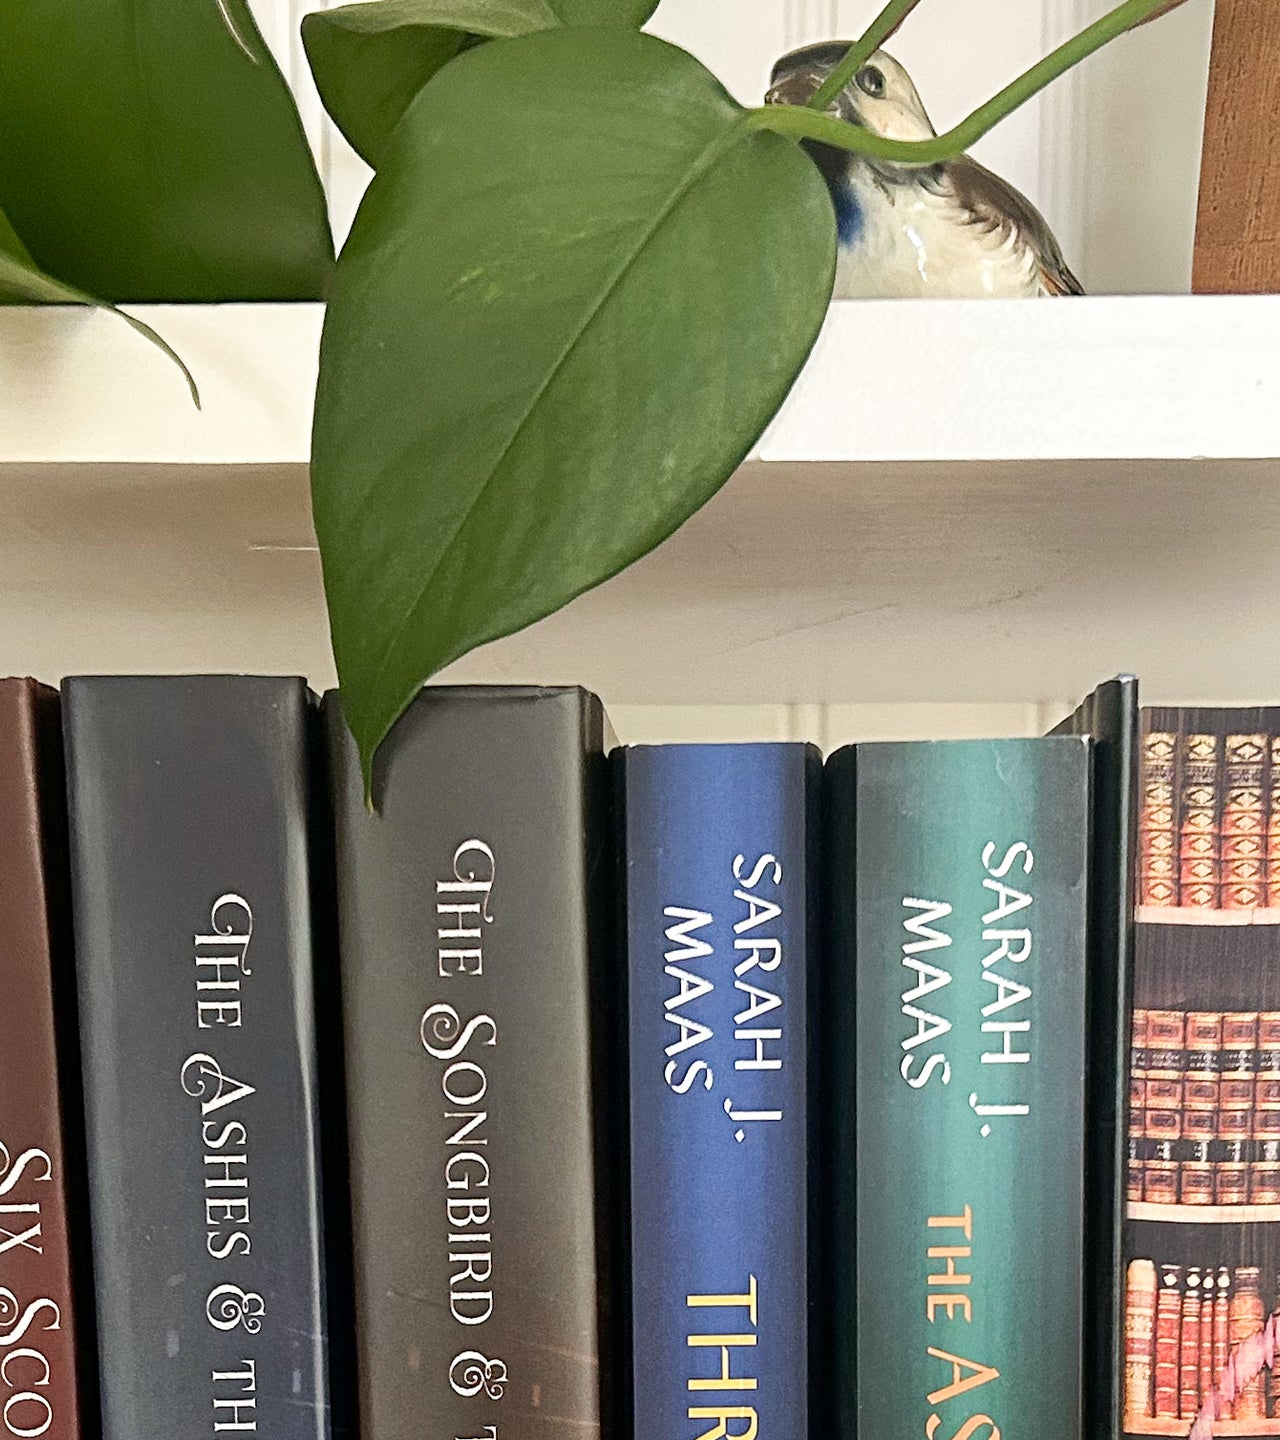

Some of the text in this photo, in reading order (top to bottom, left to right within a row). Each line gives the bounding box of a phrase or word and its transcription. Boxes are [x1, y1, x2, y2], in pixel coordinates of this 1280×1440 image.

[193, 893, 254, 1030] THE
[435, 839, 496, 978] THE
[663, 903, 715, 1096] MAAS
[724, 851, 783, 1143] SARAH J.
[900, 895, 952, 1090] MAAS
[968, 839, 1034, 1138] SARAH J.
[179, 1052, 257, 1260] ASHES
[420, 1002, 498, 1327] SONGBIRD
[205, 1283, 266, 1335] &
[926, 1203, 972, 1324] THE
[447, 1349, 509, 1401] &
